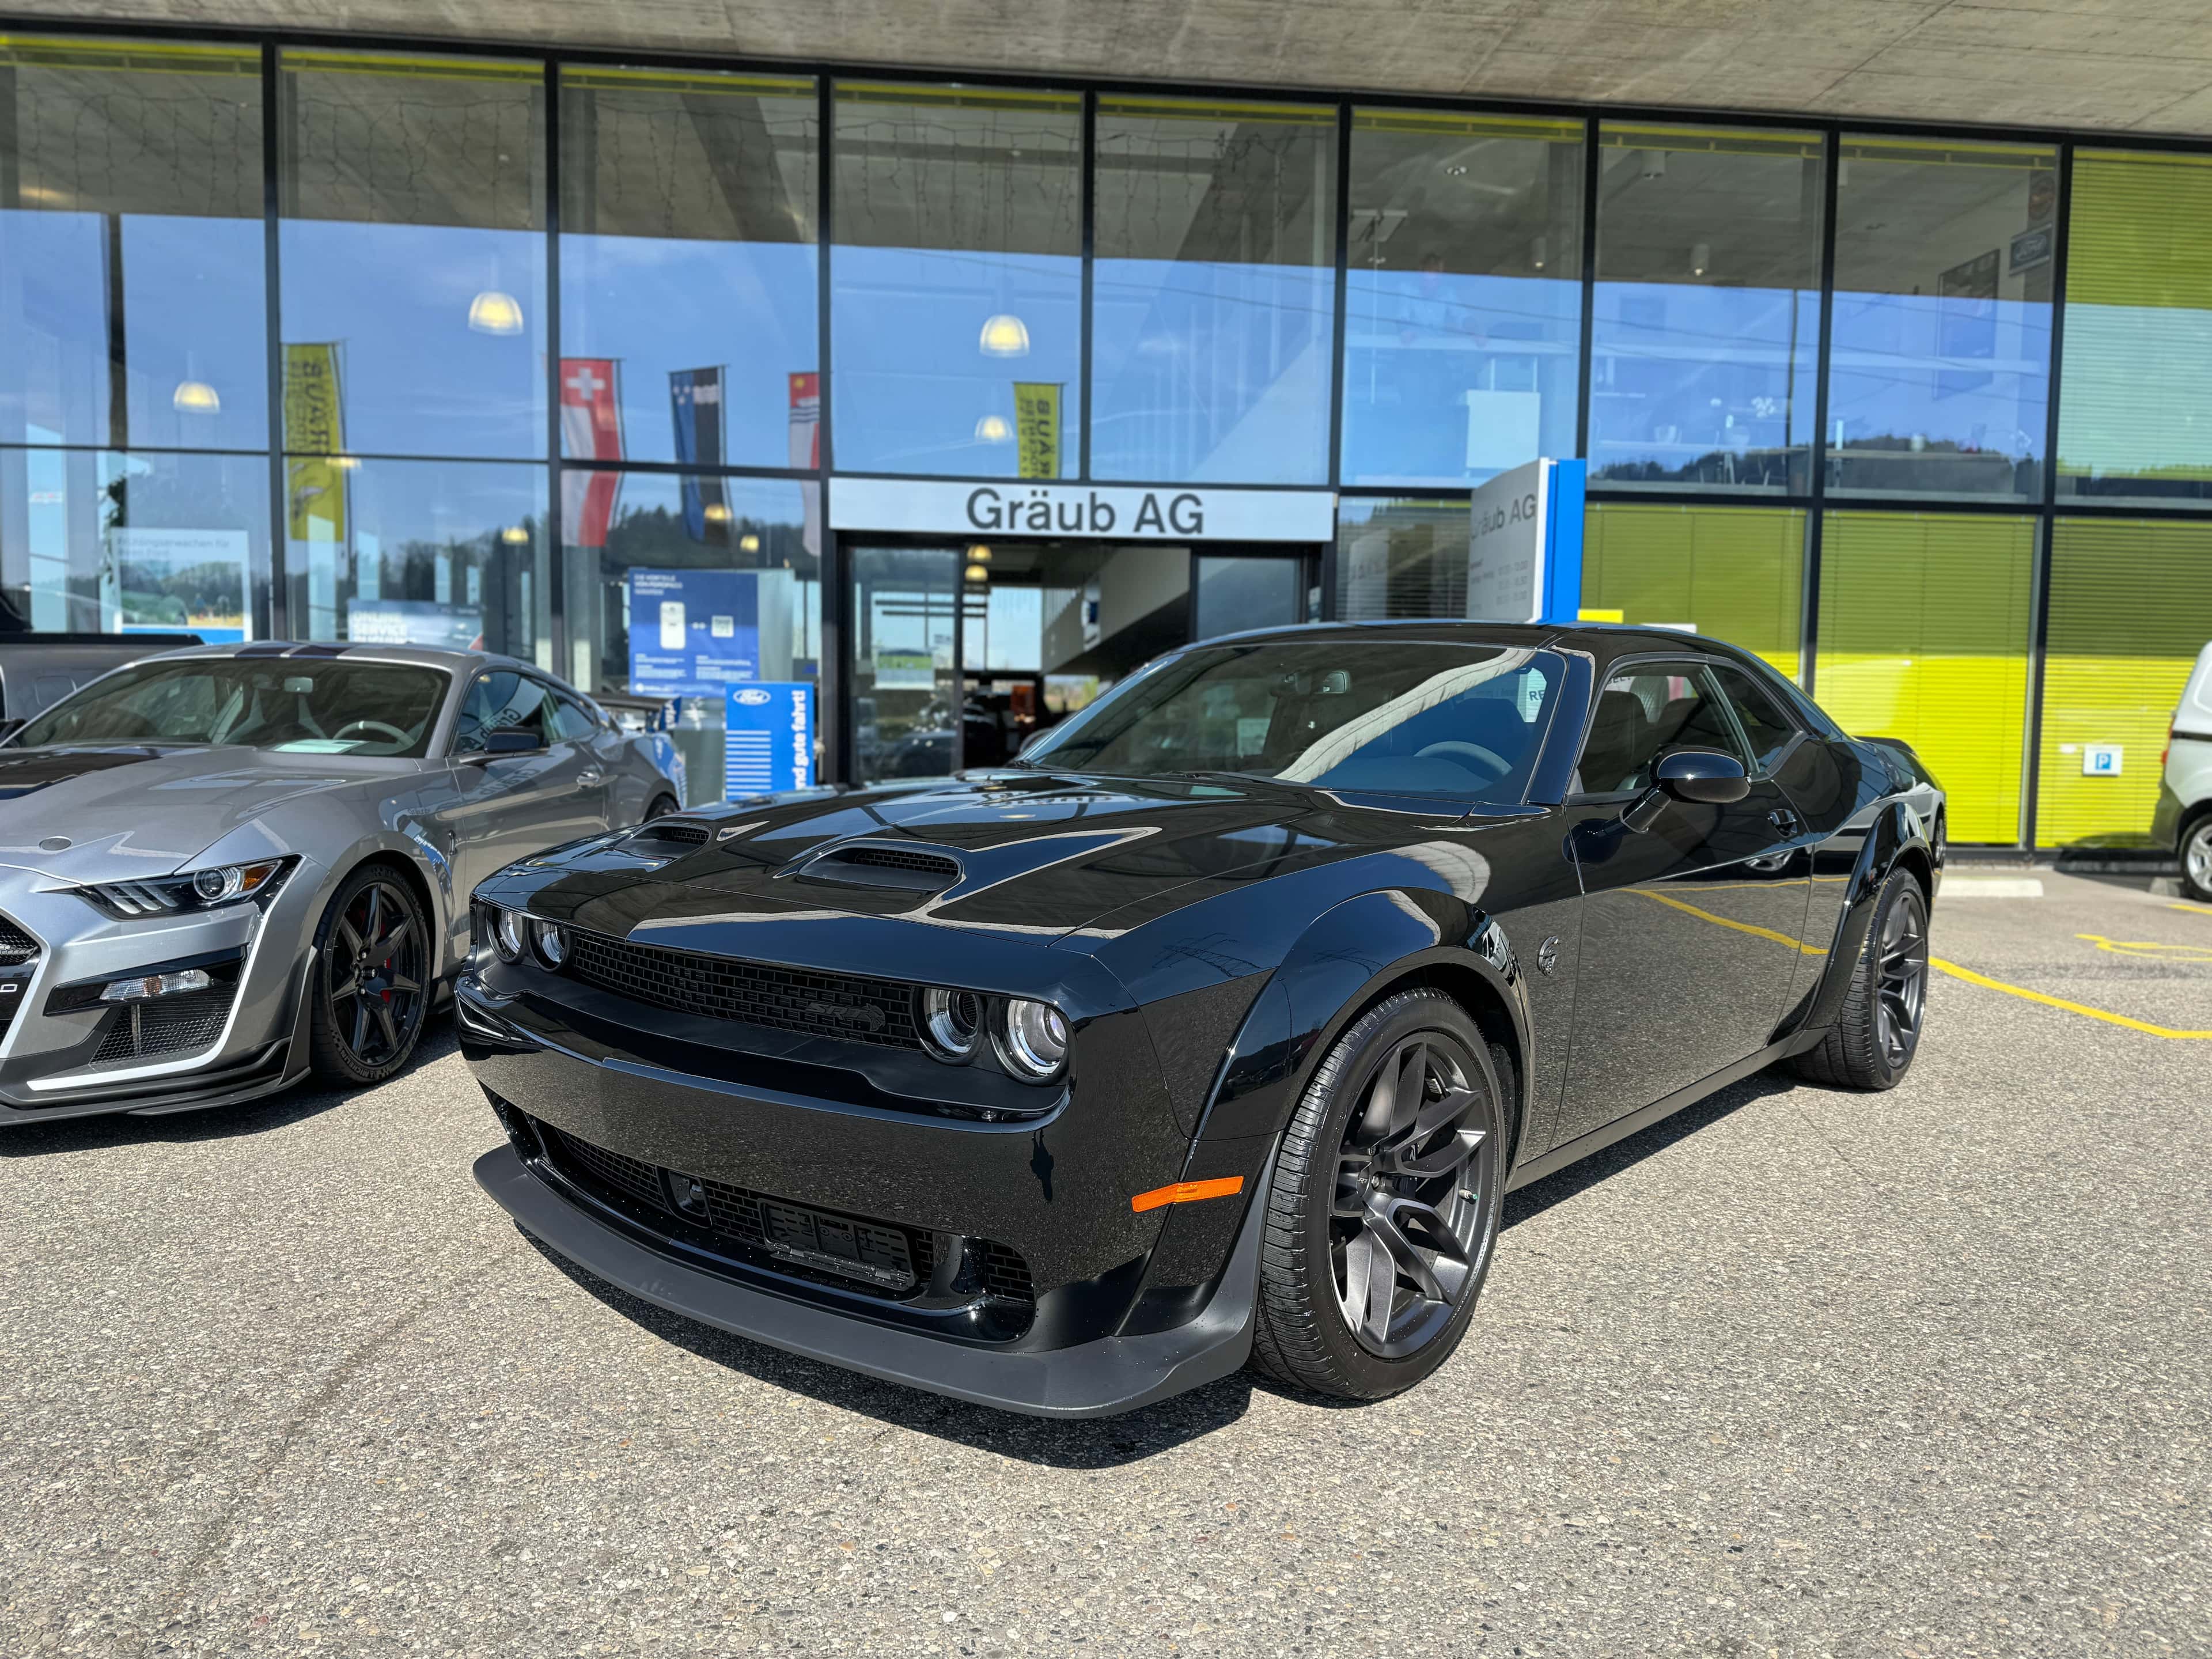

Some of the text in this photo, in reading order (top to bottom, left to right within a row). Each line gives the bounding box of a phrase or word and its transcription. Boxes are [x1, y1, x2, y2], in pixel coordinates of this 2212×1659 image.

[966, 487, 1204, 535] Gräub AG
[1509, 494, 1537, 525] AG
[791, 690, 806, 730] fahrt!
[793, 733, 809, 767] gute
[806, 1002, 869, 1021] SRT
